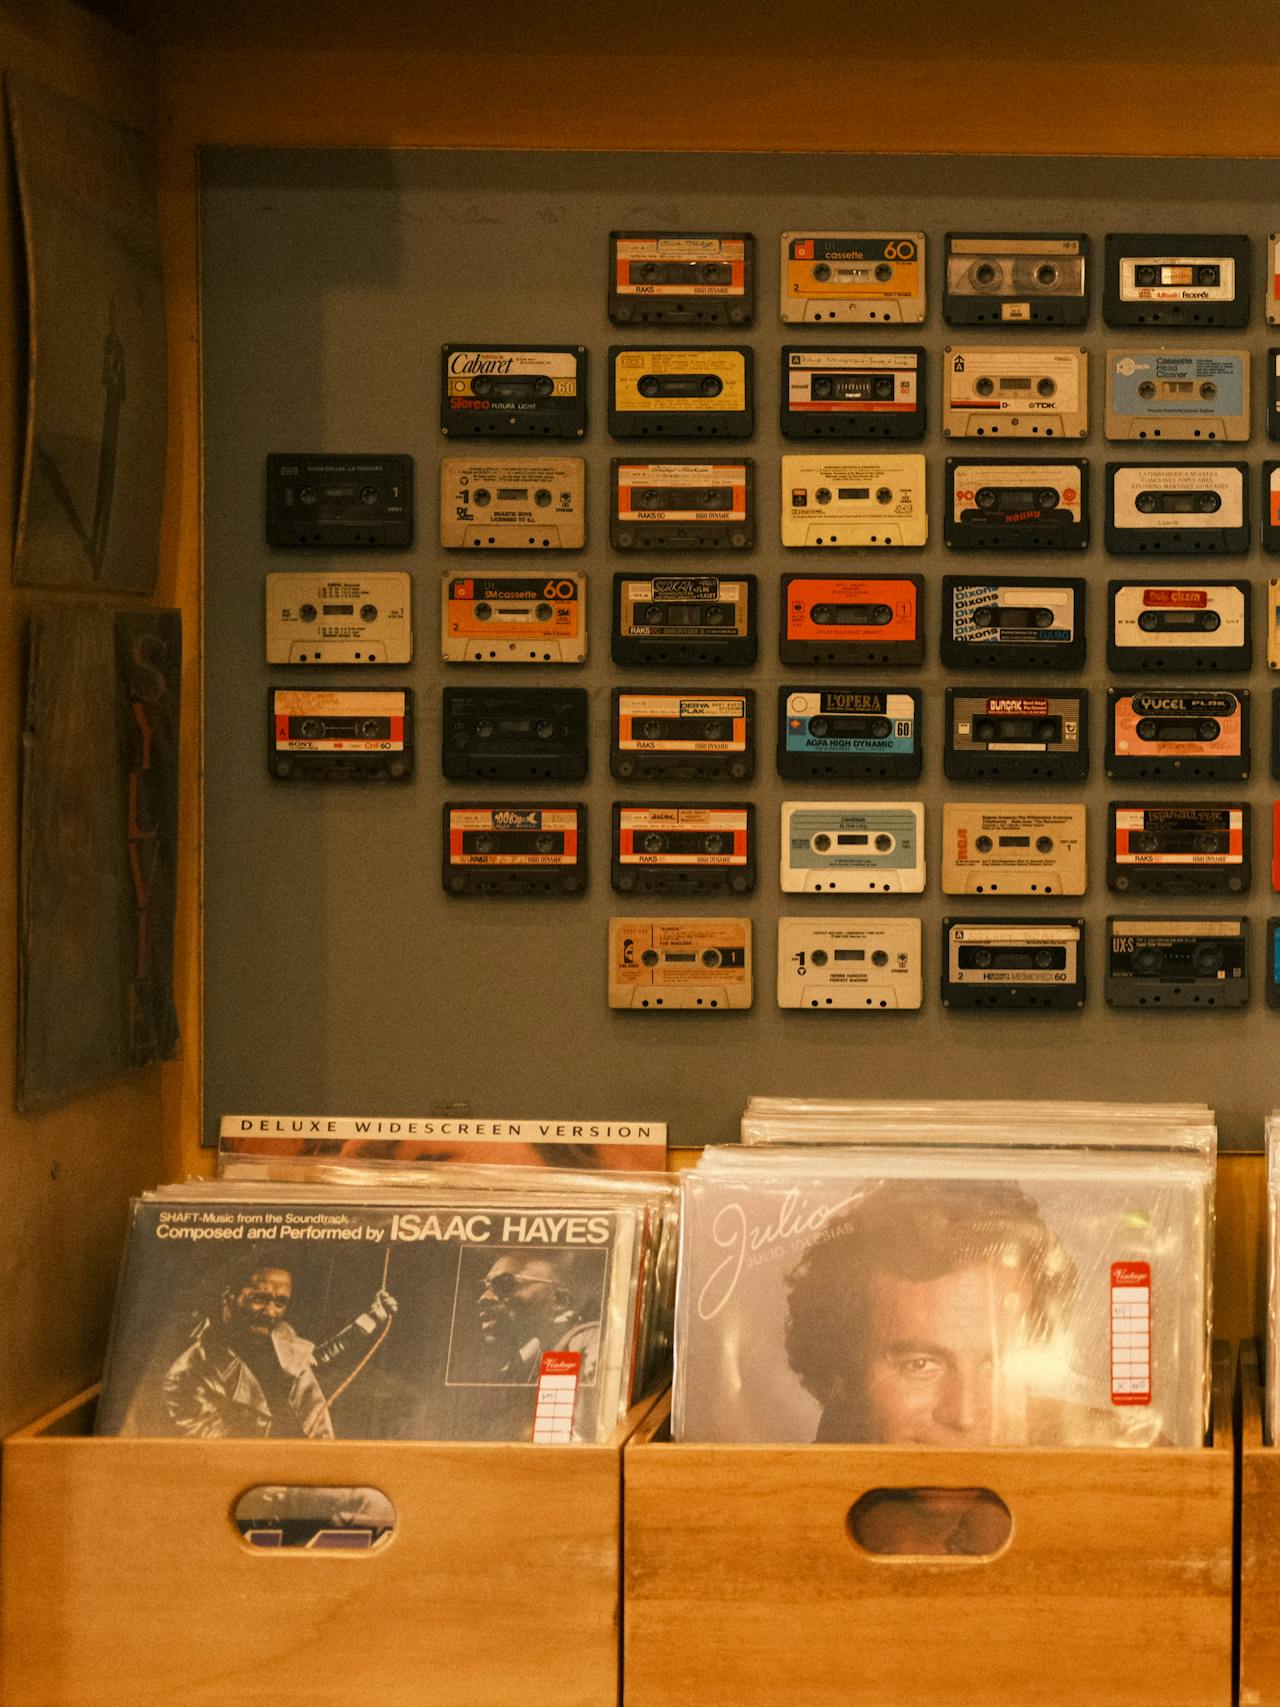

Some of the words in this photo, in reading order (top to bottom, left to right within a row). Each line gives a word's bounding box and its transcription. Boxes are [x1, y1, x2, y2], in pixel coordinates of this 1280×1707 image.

[826, 249, 864, 260] cassette
[884, 241, 915, 260] 60
[793, 284, 800, 292] 2
[451, 353, 515, 375] Cabaret
[1156, 357, 1193, 365] Cassette
[1156, 371, 1188, 379] Cleaner
[558, 382, 574, 394] 60
[450, 397, 491, 411] Stereo
[518, 402, 536, 410] LIGHT
[393, 487, 399, 497] 1
[956, 490, 974, 501] 90
[543, 579, 574, 599] 60
[955, 593, 1000, 609] Dixons
[955, 628, 999, 642] Dixons
[827, 694, 881, 708] L'OPERA
[279, 728, 287, 737] A
[897, 722, 910, 736] 60
[805, 740, 829, 748] AGFA
[830, 740, 851, 748] HIGH
[853, 740, 894, 749] DYNAMIC
[957, 829, 968, 860] RCA
[1112, 938, 1135, 953] UX-S
[958, 972, 964, 980] 2
[1055, 972, 1067, 981] 60
[240, 1119, 337, 1133] DELUXE
[355, 1121, 522, 1136] WIDESCREEN
[539, 1124, 653, 1139] VERSION
[237, 1213, 263, 1225] from
[265, 1213, 282, 1225] the
[284, 1214, 350, 1227] Soundtrack
[156, 1224, 244, 1241] Composed
[247, 1225, 277, 1239] and
[280, 1226, 362, 1241] Performed
[364, 1227, 385, 1243] by
[390, 1214, 491, 1242] ISAAC
[502, 1216, 610, 1245] HAYES
[698, 1186, 866, 1320] Julio
[746, 1245, 785, 1269] JULIO
